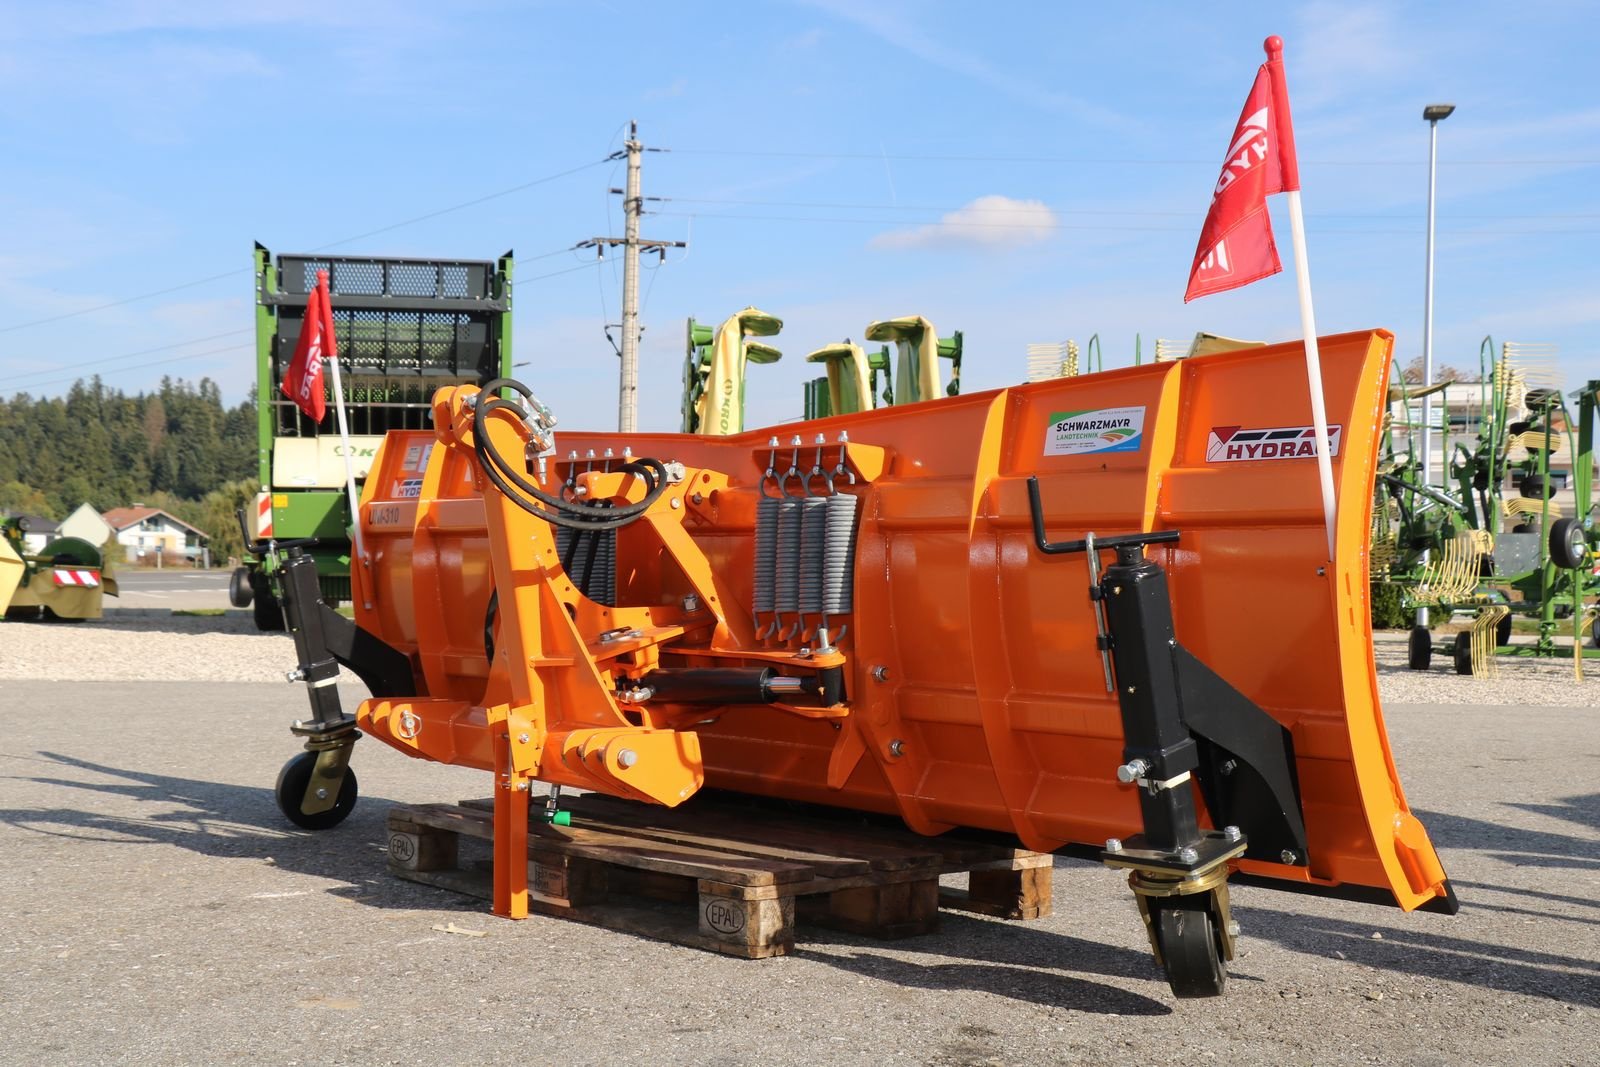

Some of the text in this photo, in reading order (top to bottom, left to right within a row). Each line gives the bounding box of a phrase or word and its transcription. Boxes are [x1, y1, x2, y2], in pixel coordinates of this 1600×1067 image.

[1056, 418, 1131, 432] SCHWARZMAYR
[1056, 432, 1099, 441] LANDTECHNIK
[393, 838, 411, 857] EPAL
[711, 905, 739, 929] EPAL
